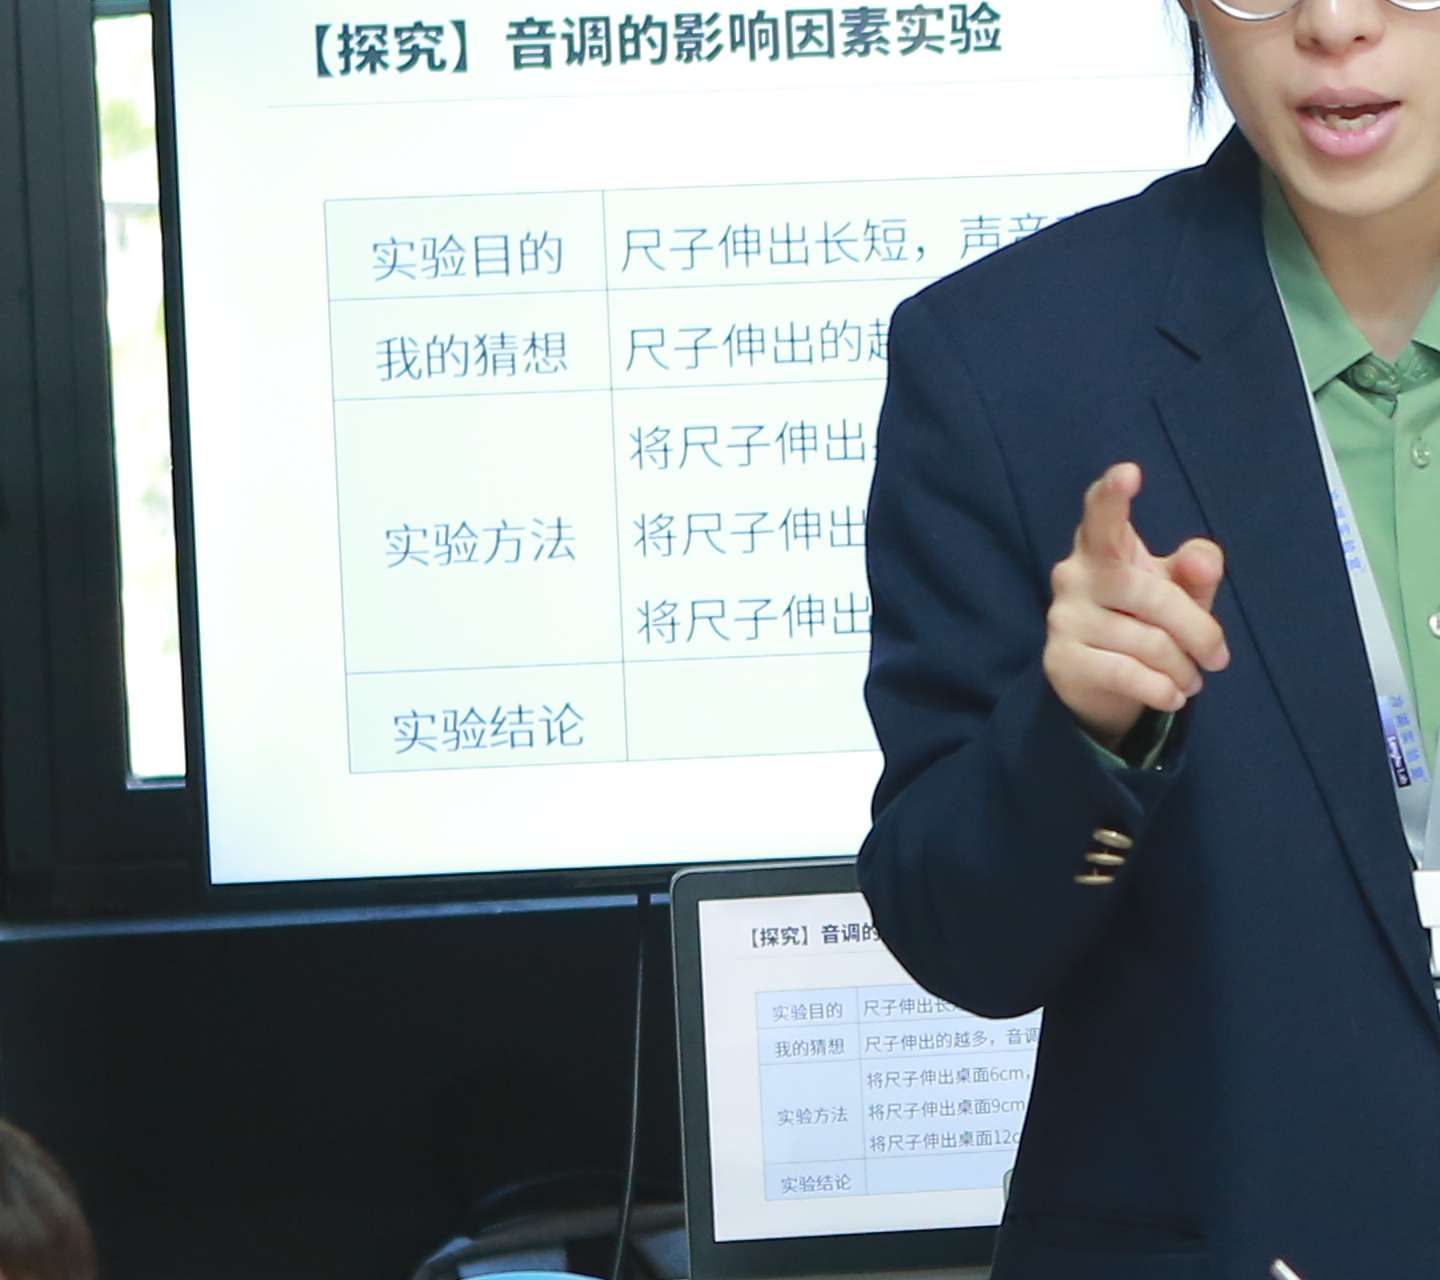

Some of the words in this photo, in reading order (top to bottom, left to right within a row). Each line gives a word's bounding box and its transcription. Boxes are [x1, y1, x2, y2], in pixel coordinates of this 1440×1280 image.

[372, 230, 563, 282] 实验目的
[375, 331, 568, 382] 我的猜想
[628, 418, 877, 471] 将尺子伸出
[384, 515, 577, 569] 实验方法
[633, 505, 867, 558] 将尺子伸出
[637, 591, 873, 645] 将尺子伸出
[393, 701, 585, 755] 实验结论
[772, 1001, 844, 1022] 实验目的
[863, 997, 960, 1017] 尺子伸出长
[775, 1038, 846, 1059] 我的猜想
[777, 1105, 849, 1127] 实验方法
[780, 1174, 852, 1195] 实验结论
